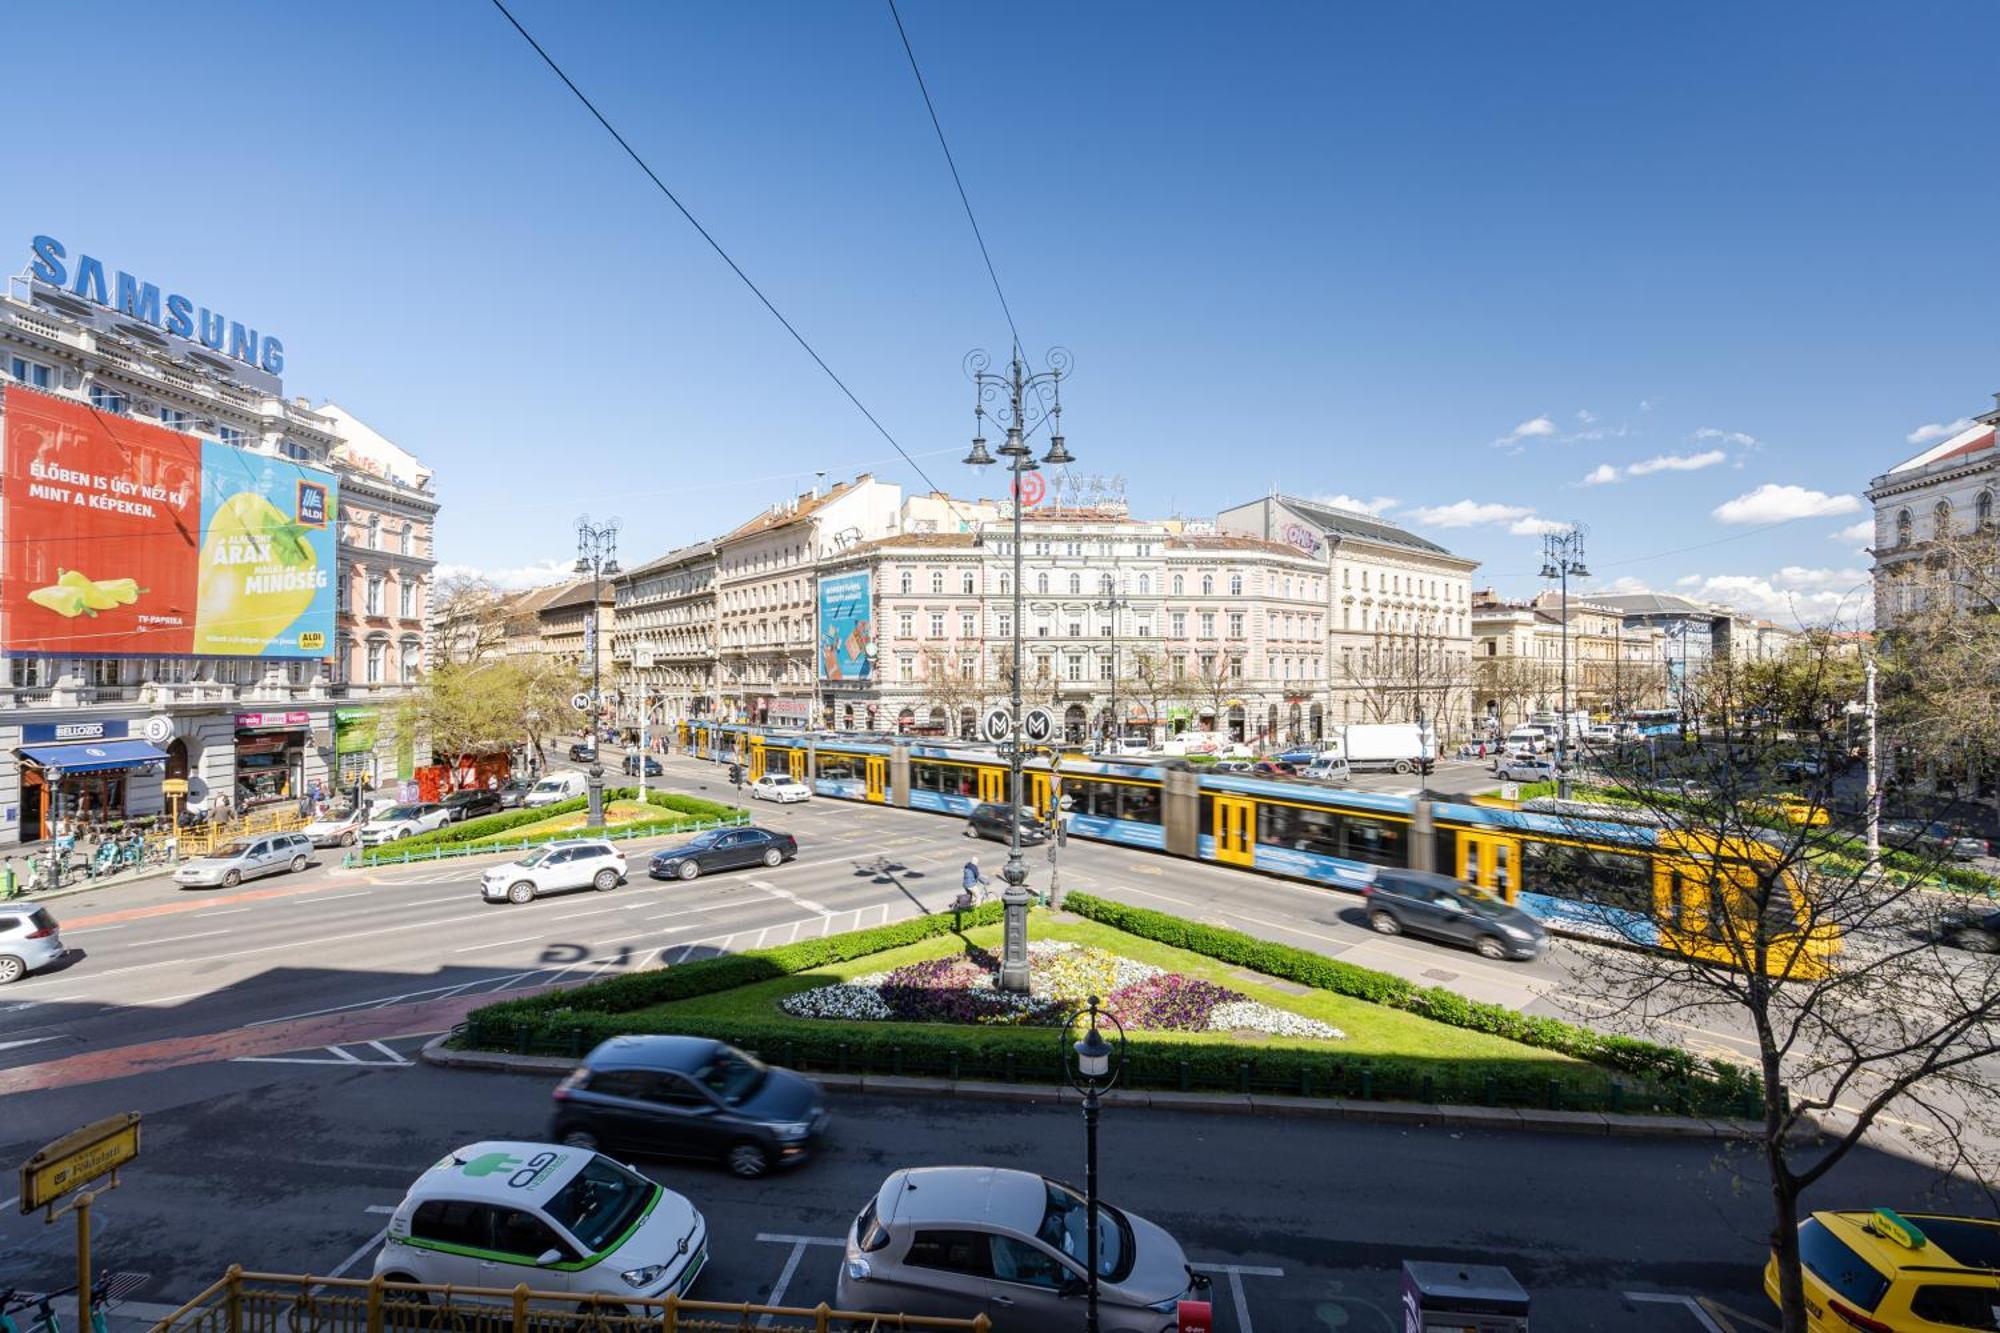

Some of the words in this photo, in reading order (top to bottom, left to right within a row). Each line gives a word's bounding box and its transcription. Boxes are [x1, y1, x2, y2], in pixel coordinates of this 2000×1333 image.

[31, 235, 284, 374] SAMSUNG
[30, 459, 90, 488] ÉLŐBEN
[93, 474, 107, 490] IS
[111, 477, 139, 497] ÚGY
[141, 484, 167, 502] NÉZ
[29, 484, 72, 504] MINT
[73, 491, 86, 506] A
[88, 493, 157, 519] KÉPEKEN.
[301, 508, 323, 520] ALDI
[302, 632, 321, 641] ALDI
[56, 725, 104, 738] BELLOZZO
[151, 723, 161, 735] B
[992, 715, 1007, 736] M
[1028, 715, 1045, 736] M
